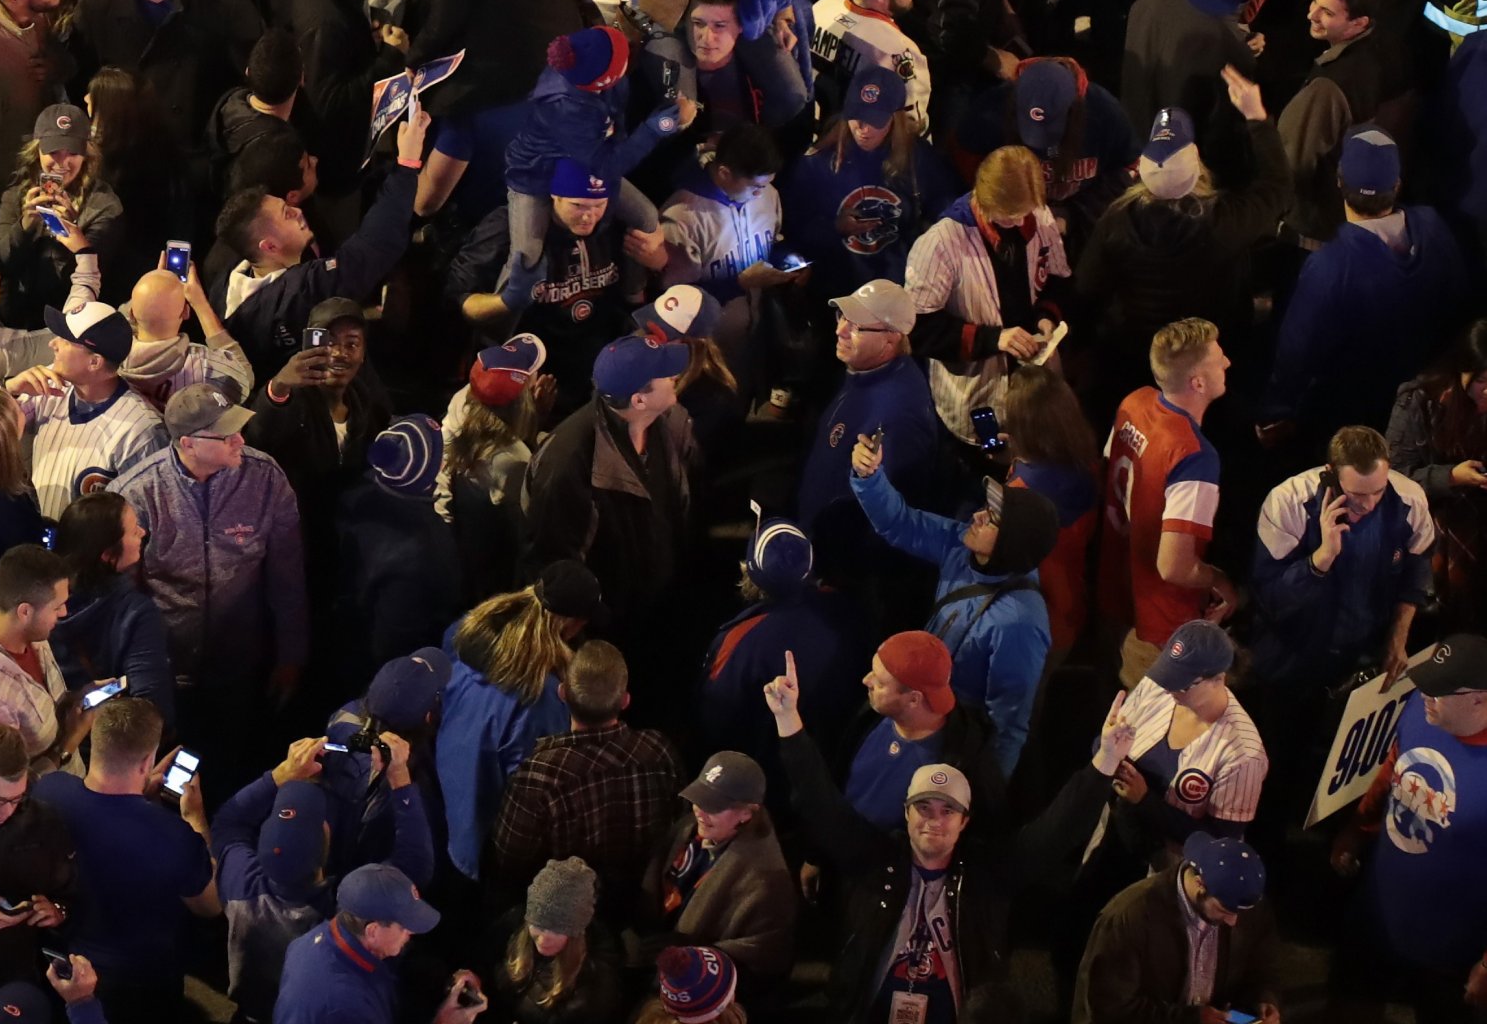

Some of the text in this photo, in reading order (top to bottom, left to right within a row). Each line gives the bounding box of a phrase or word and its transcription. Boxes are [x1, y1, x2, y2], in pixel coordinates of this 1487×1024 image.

[1028, 107, 1045, 122] C
[56, 115, 72, 130] C
[535, 280, 581, 304] WORLD
[857, 285, 874, 299] C
[663, 297, 679, 312] C
